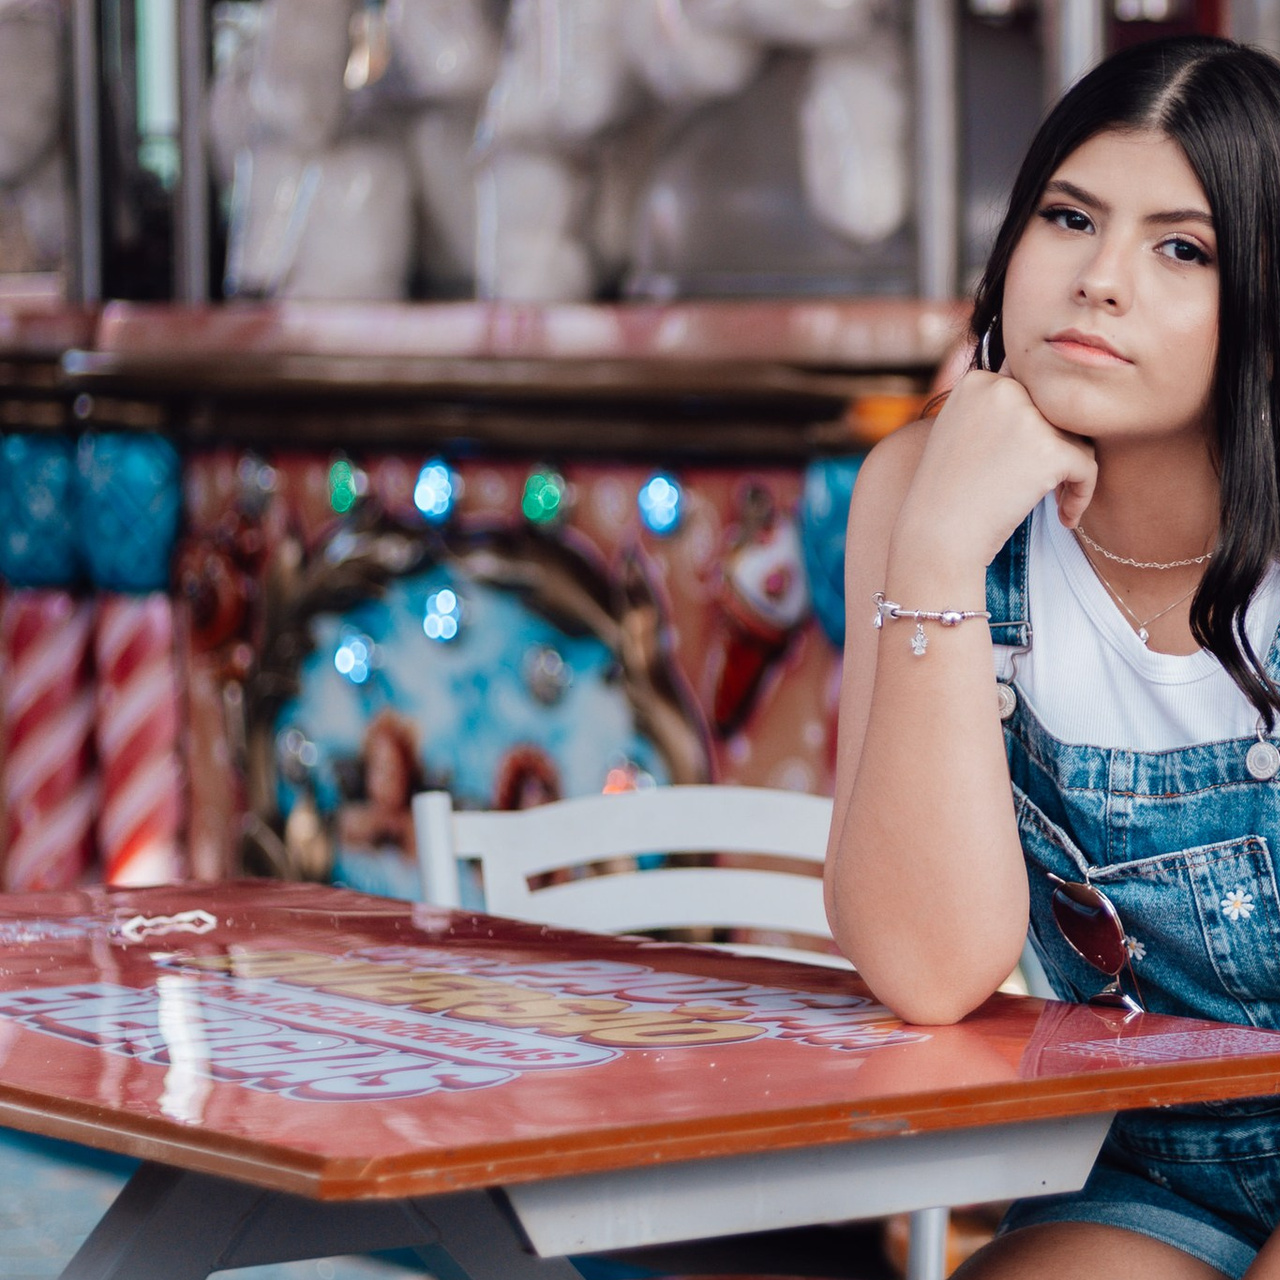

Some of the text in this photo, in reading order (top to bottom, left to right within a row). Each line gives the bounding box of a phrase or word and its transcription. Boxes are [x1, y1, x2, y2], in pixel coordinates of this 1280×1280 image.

[182, 950, 770, 1047] DIVERSÃO
[266, 1002, 519, 1051] RECARREGAR
[498, 1046, 581, 1062] AS
[465, 957, 905, 1032] PAUSA
[0, 982, 522, 1102] ENERGIAS
